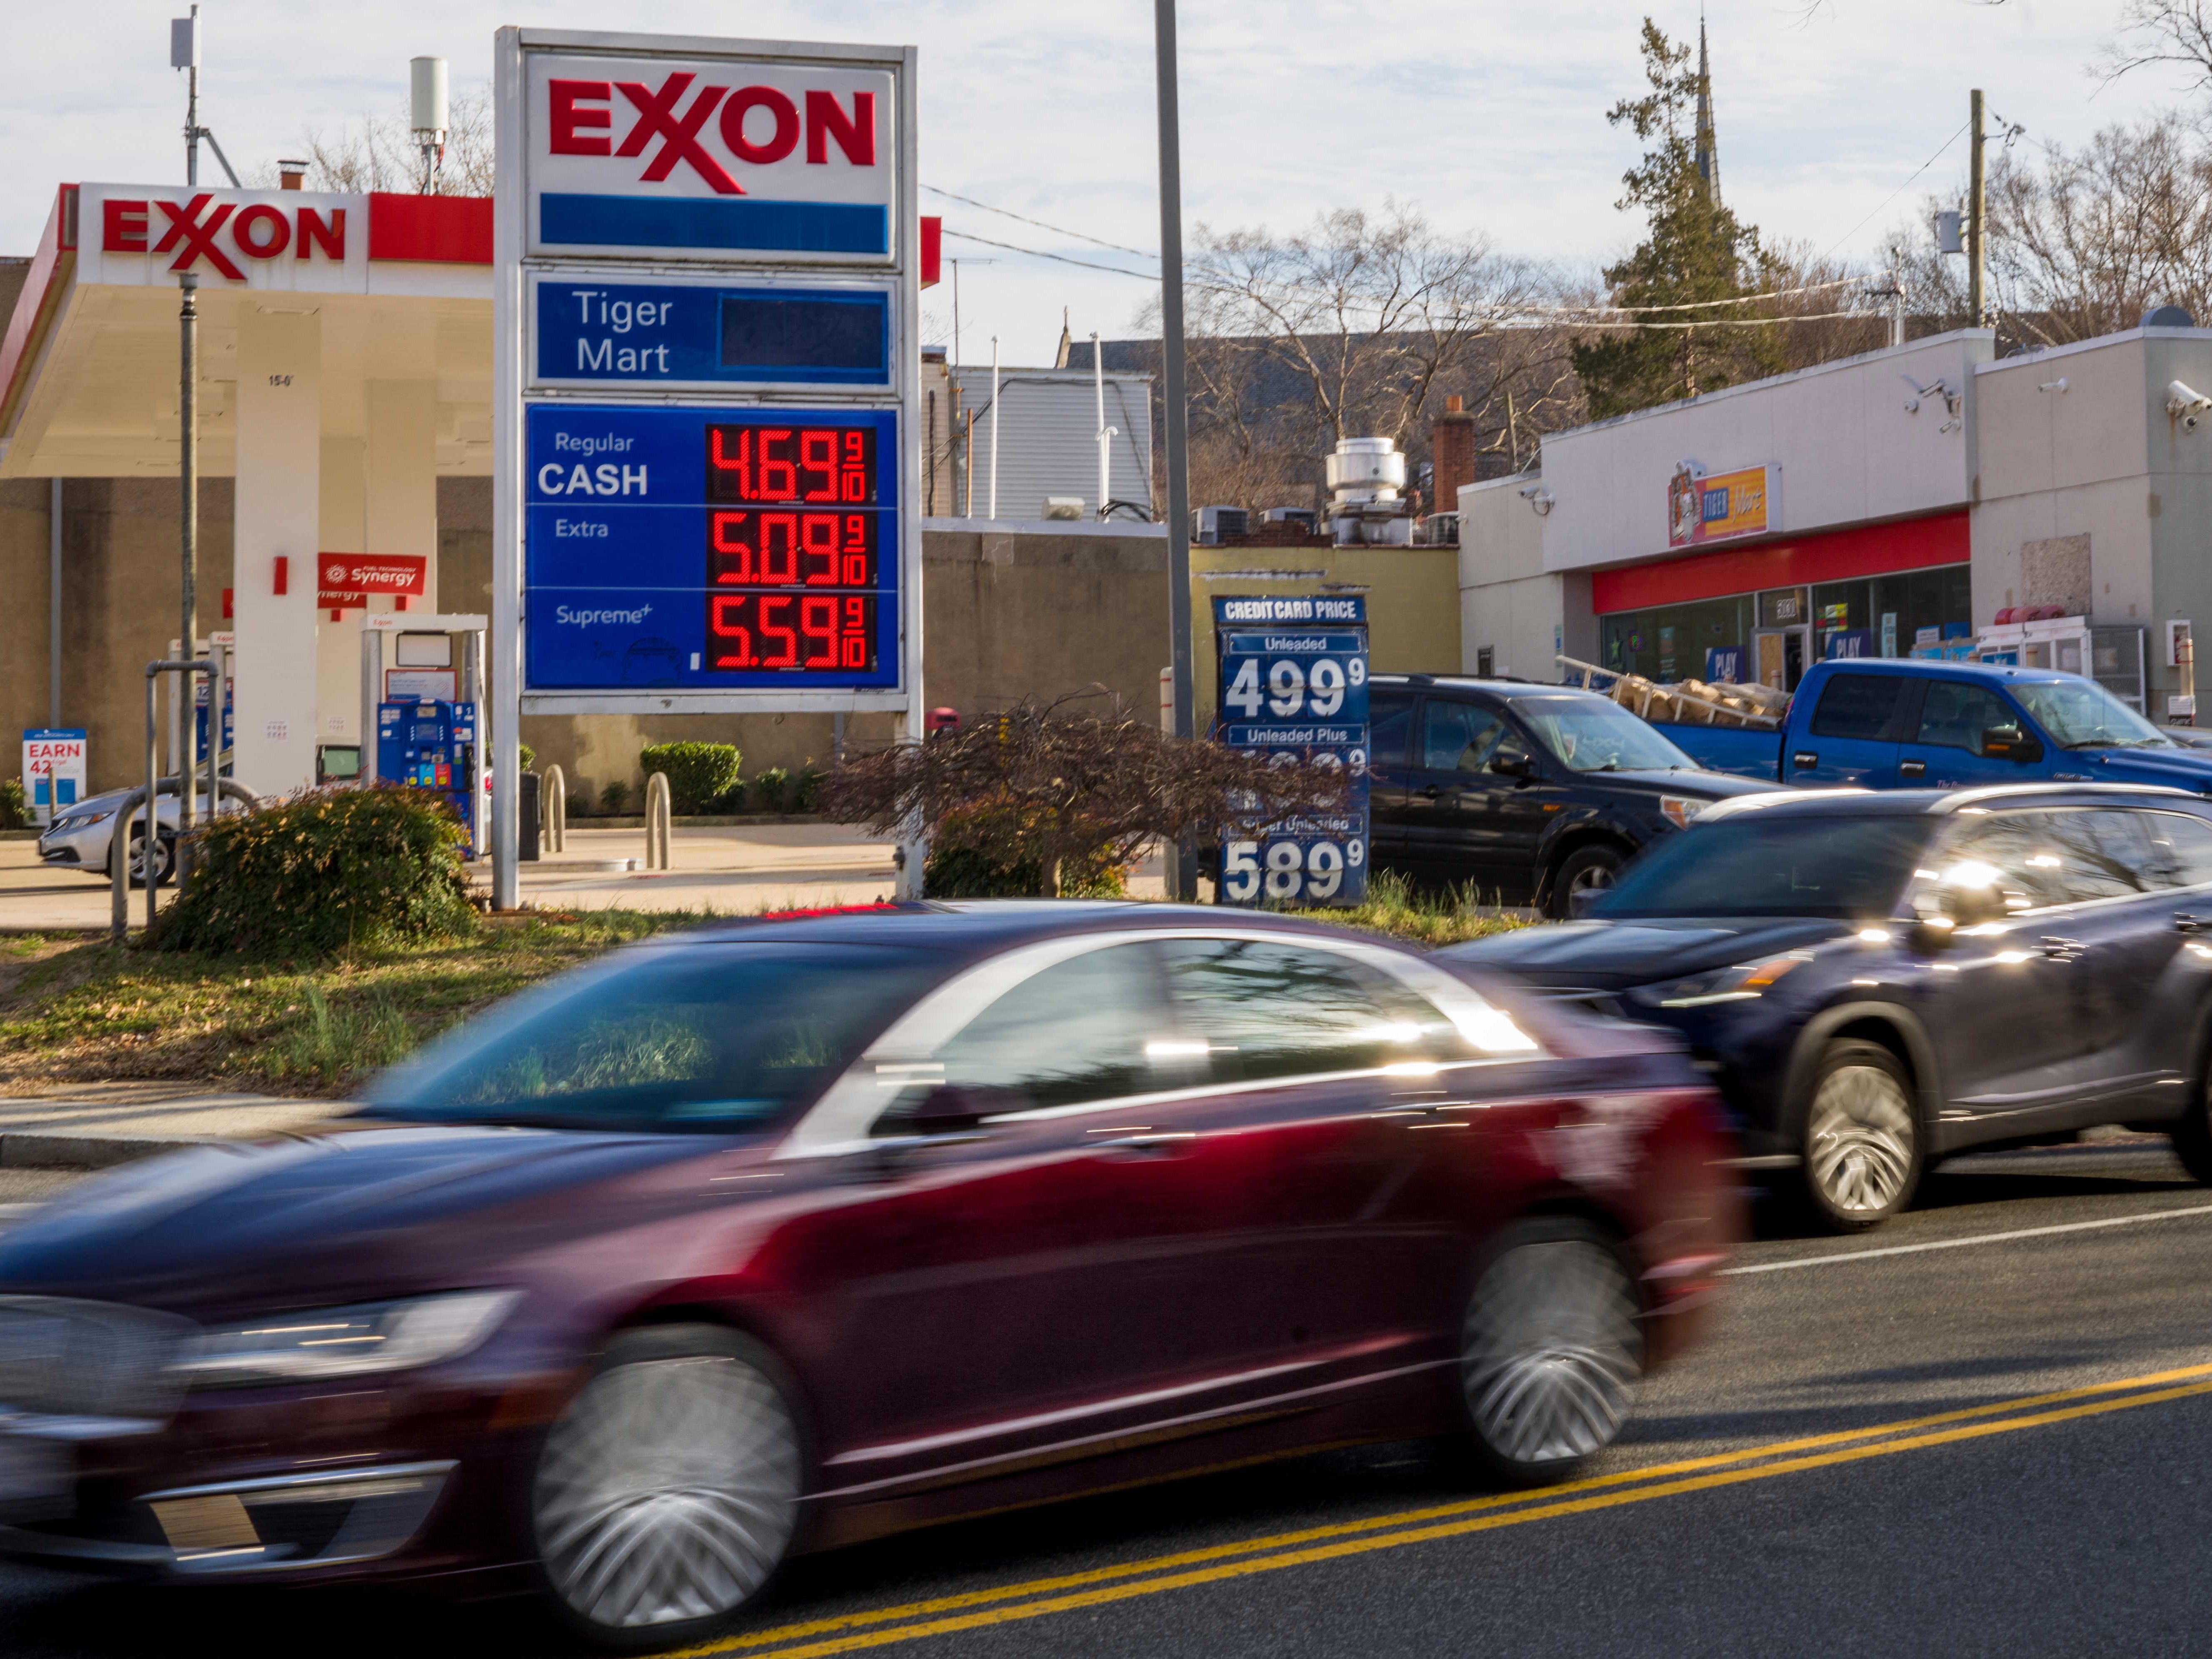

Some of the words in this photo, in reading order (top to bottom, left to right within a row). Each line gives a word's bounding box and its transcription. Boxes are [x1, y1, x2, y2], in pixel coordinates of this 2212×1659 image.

[549, 71, 876, 195] EXXON
[103, 193, 347, 282] EXXON
[572, 291, 673, 333] Tiger
[578, 337, 669, 372] Mart
[555, 432, 633, 455] Regular
[538, 463, 647, 496] CASH
[556, 519, 608, 538] Extra
[351, 568, 416, 586] Synergy
[1225, 601, 1274, 620] CREDIT
[1274, 601, 1312, 619] CARD
[1315, 601, 1357, 619] PRICE
[1265, 637, 1327, 652] Unleaded
[1837, 636, 1861, 658] PLAY
[1715, 653, 1738, 677] PLAY
[1247, 728, 1313, 742] Unleaded
[1317, 728, 1348, 741] Plus
[30, 743, 80, 757] EARN
